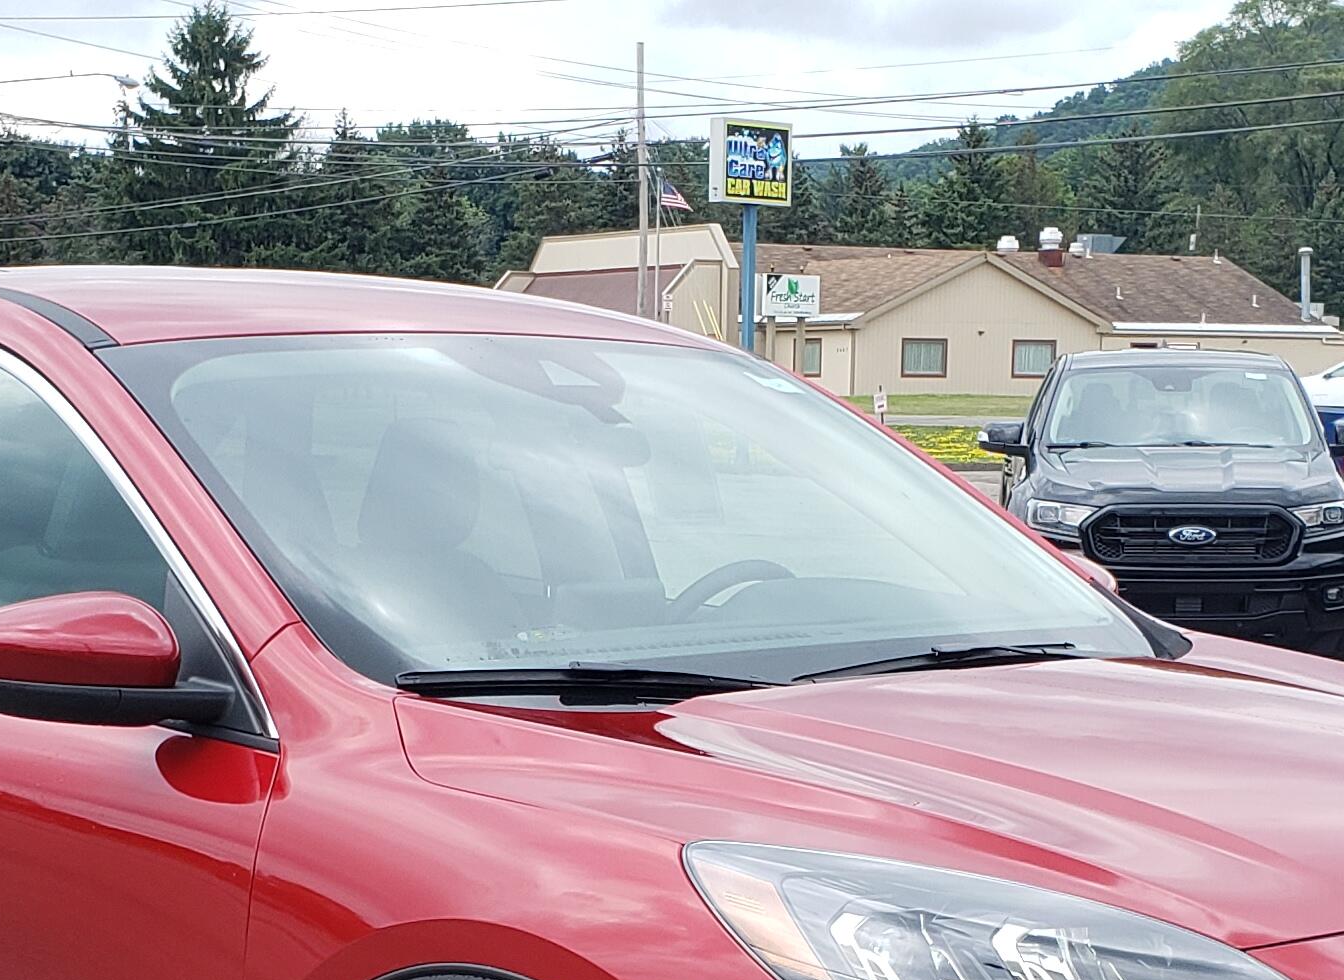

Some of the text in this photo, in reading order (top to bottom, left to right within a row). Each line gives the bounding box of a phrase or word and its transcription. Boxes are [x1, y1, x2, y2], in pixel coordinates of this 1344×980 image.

[727, 158, 765, 179] Care
[727, 178, 786, 198] CAR WASH
